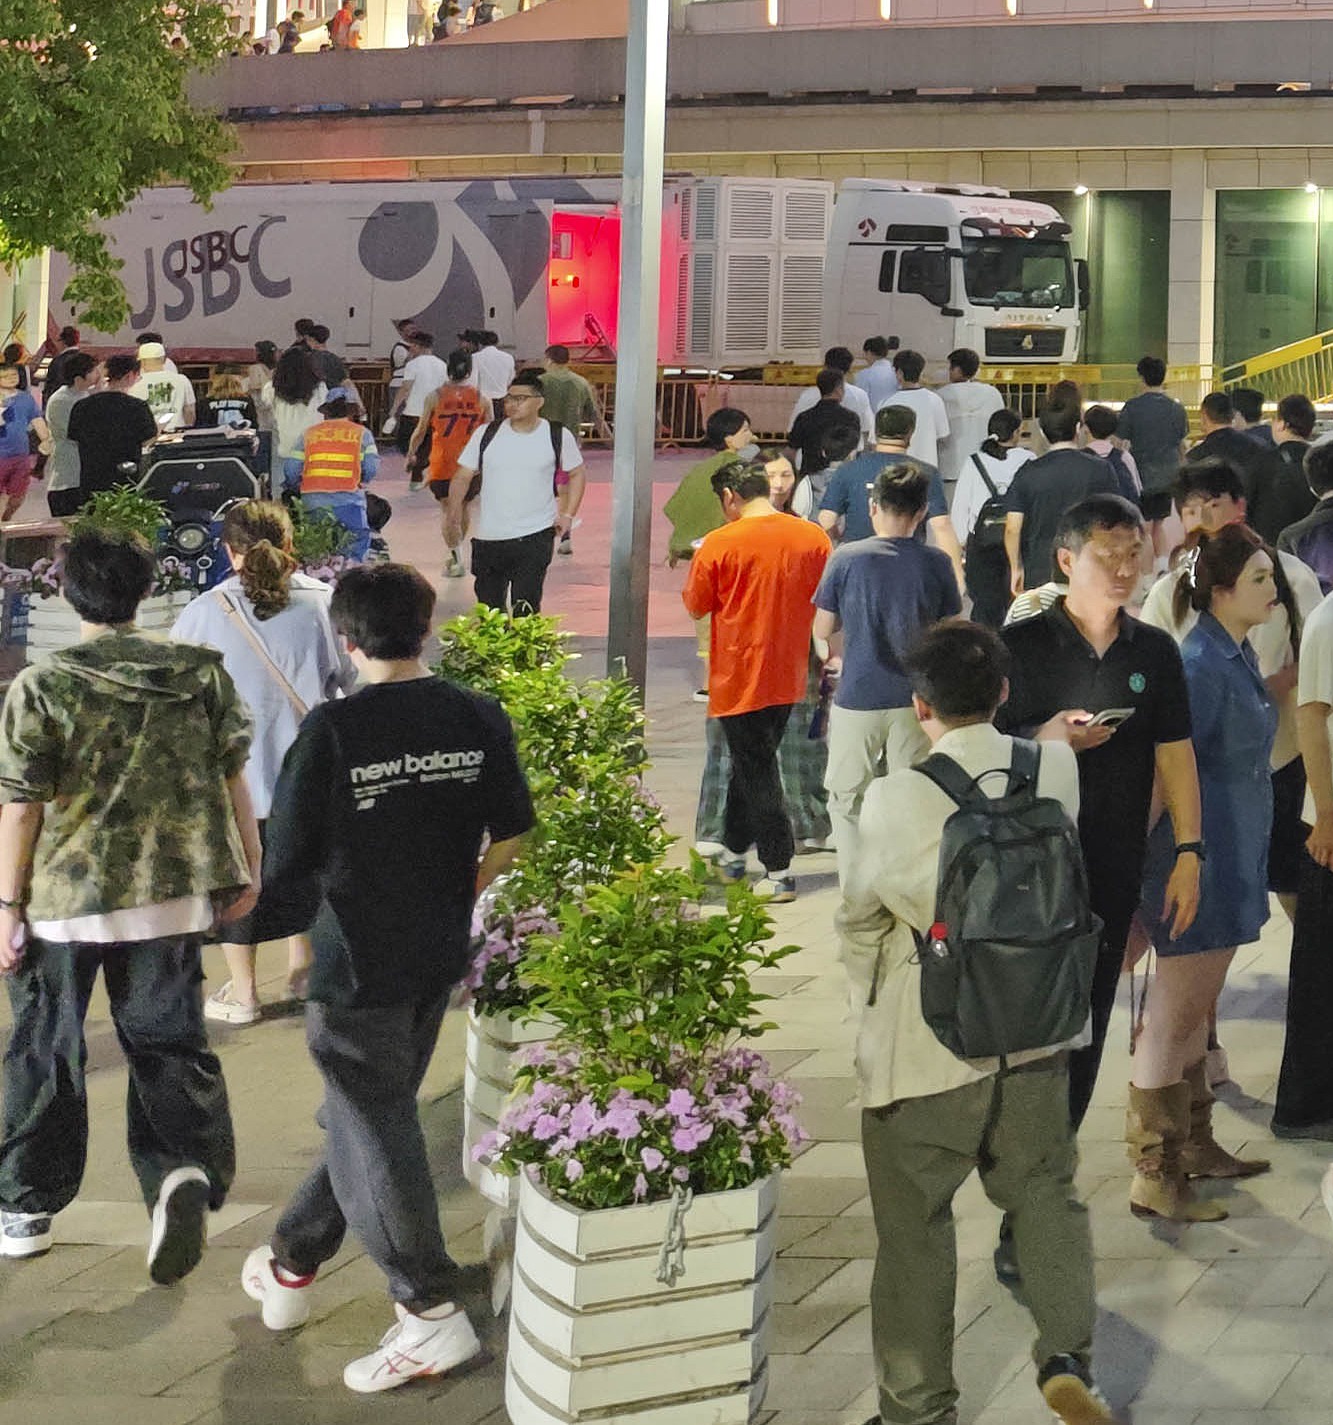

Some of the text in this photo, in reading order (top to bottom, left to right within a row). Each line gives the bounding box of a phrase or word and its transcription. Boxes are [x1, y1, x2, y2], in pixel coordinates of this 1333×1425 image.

[130, 215, 292, 329] JSBC
[173, 225, 249, 278] JSBC
[438, 413, 479, 438] 77
[351, 750, 485, 783] new balance
